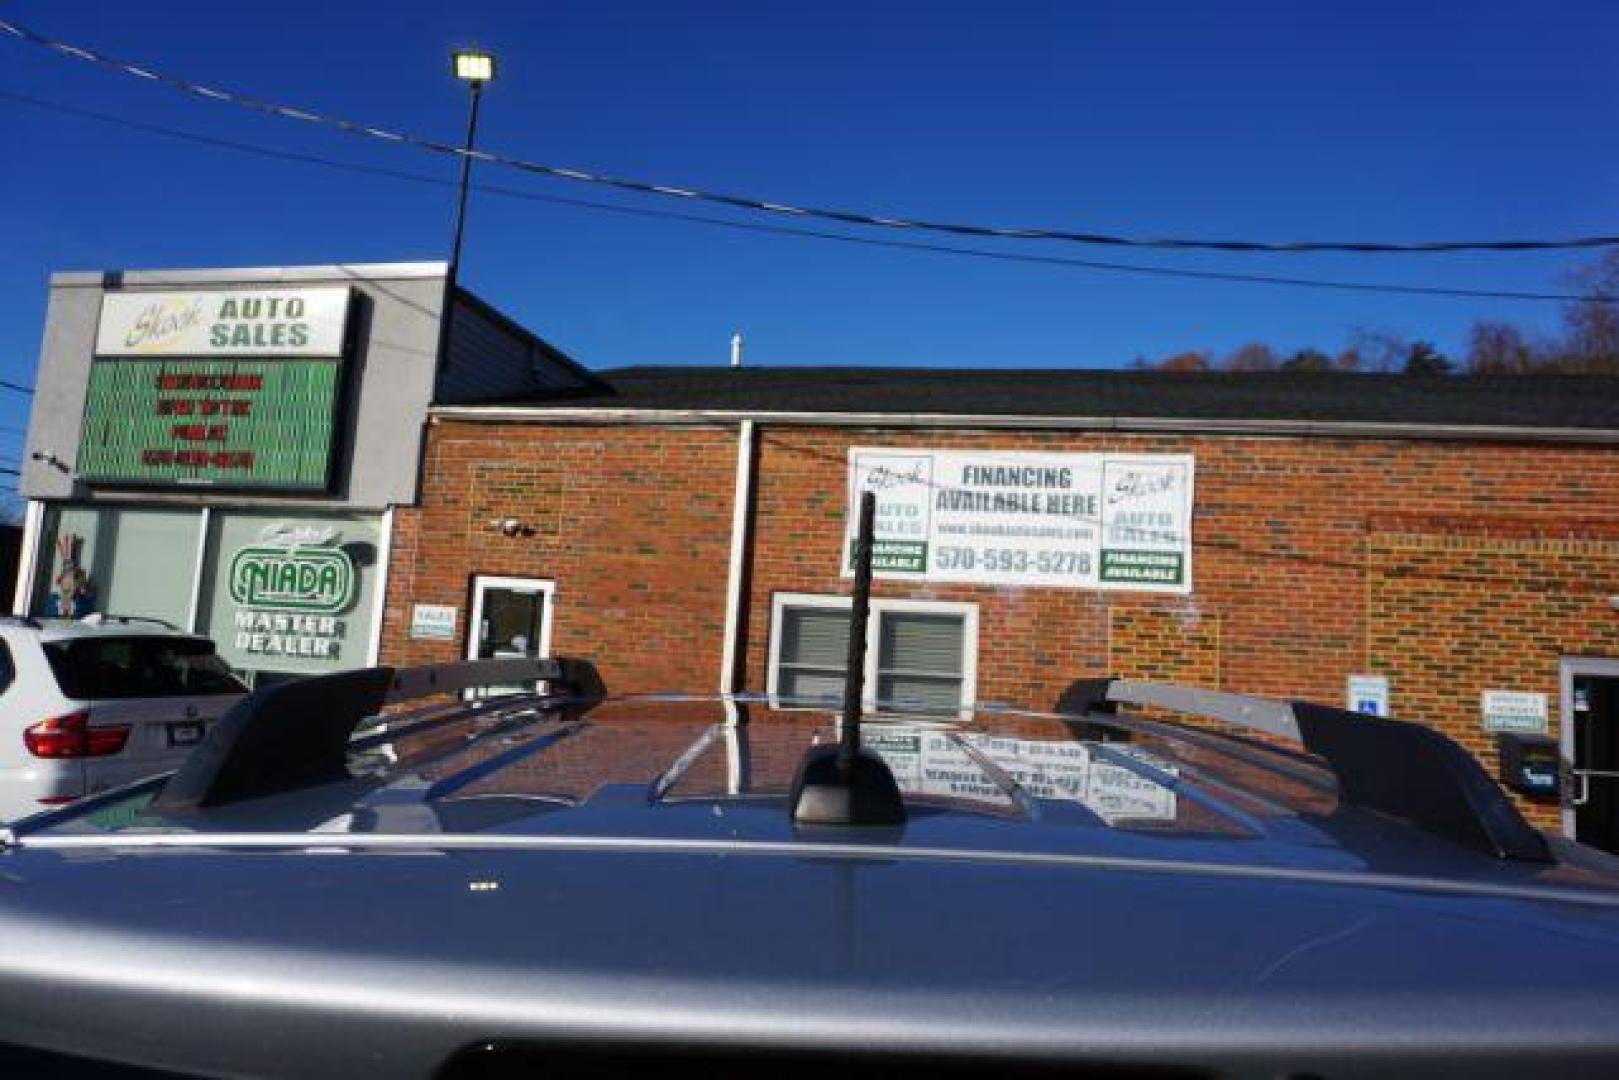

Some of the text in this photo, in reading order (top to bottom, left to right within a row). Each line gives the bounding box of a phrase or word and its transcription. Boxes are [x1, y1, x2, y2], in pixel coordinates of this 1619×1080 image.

[219, 298, 305, 320] AUTO
[209, 322, 310, 347] SALES
[963, 464, 1072, 489] FINANCING
[936, 489, 1098, 516] AVAILABLE HERE
[936, 546, 1092, 575] 570-593-5278
[240, 561, 338, 600] NIADA
[234, 610, 336, 634] MASTER
